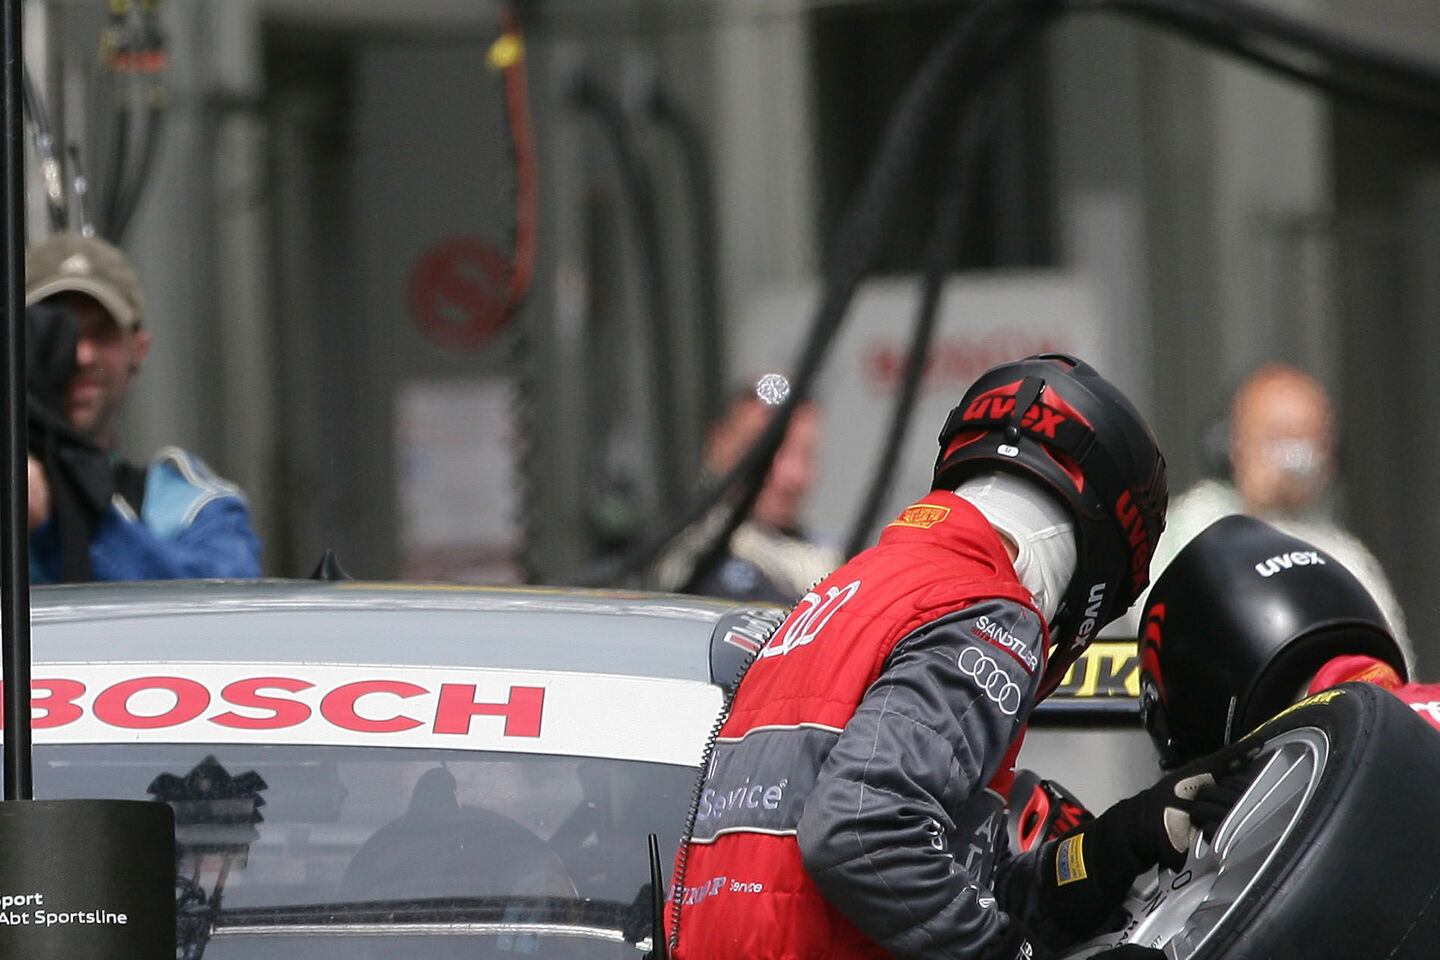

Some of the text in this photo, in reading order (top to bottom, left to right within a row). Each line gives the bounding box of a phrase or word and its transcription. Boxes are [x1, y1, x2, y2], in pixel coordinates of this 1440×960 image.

[1255, 551, 1325, 577] uvex
[1070, 582, 1107, 650] uvex
[975, 615, 1038, 672] SANDTLER
[35, 910, 127, 927] Sportsline
